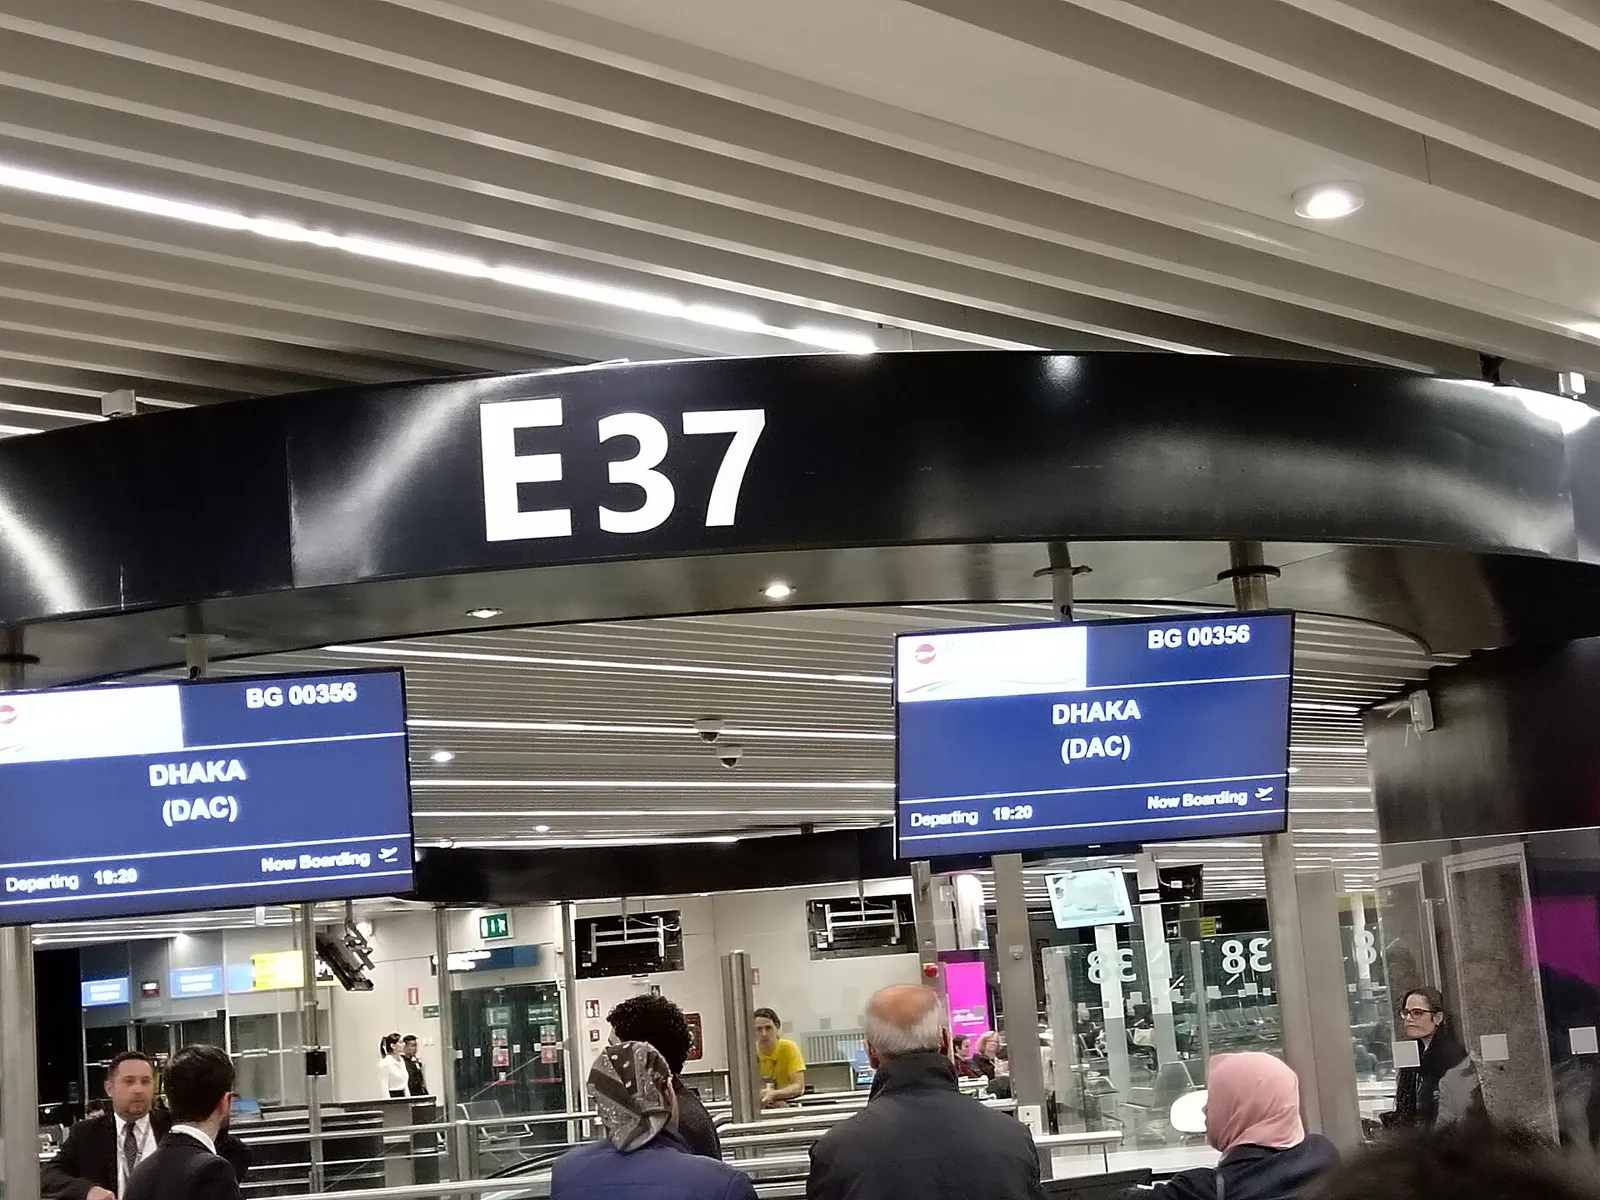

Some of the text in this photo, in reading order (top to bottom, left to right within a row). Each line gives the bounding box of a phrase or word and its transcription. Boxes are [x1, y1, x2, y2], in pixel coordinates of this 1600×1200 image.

[1147, 624, 1251, 649] BG 00356
[245, 681, 358, 709] BG 00356
[1051, 699, 1142, 725] DHAKA
[1060, 735, 1131, 765] (DAC)
[148, 759, 247, 787] DHAKA
[162, 796, 238, 827] (DAC)
[1147, 788, 1249, 810] Now Boarding
[910, 810, 979, 829] Departing
[260, 850, 371, 873] Now Boarding
[5, 873, 80, 893] Departing
